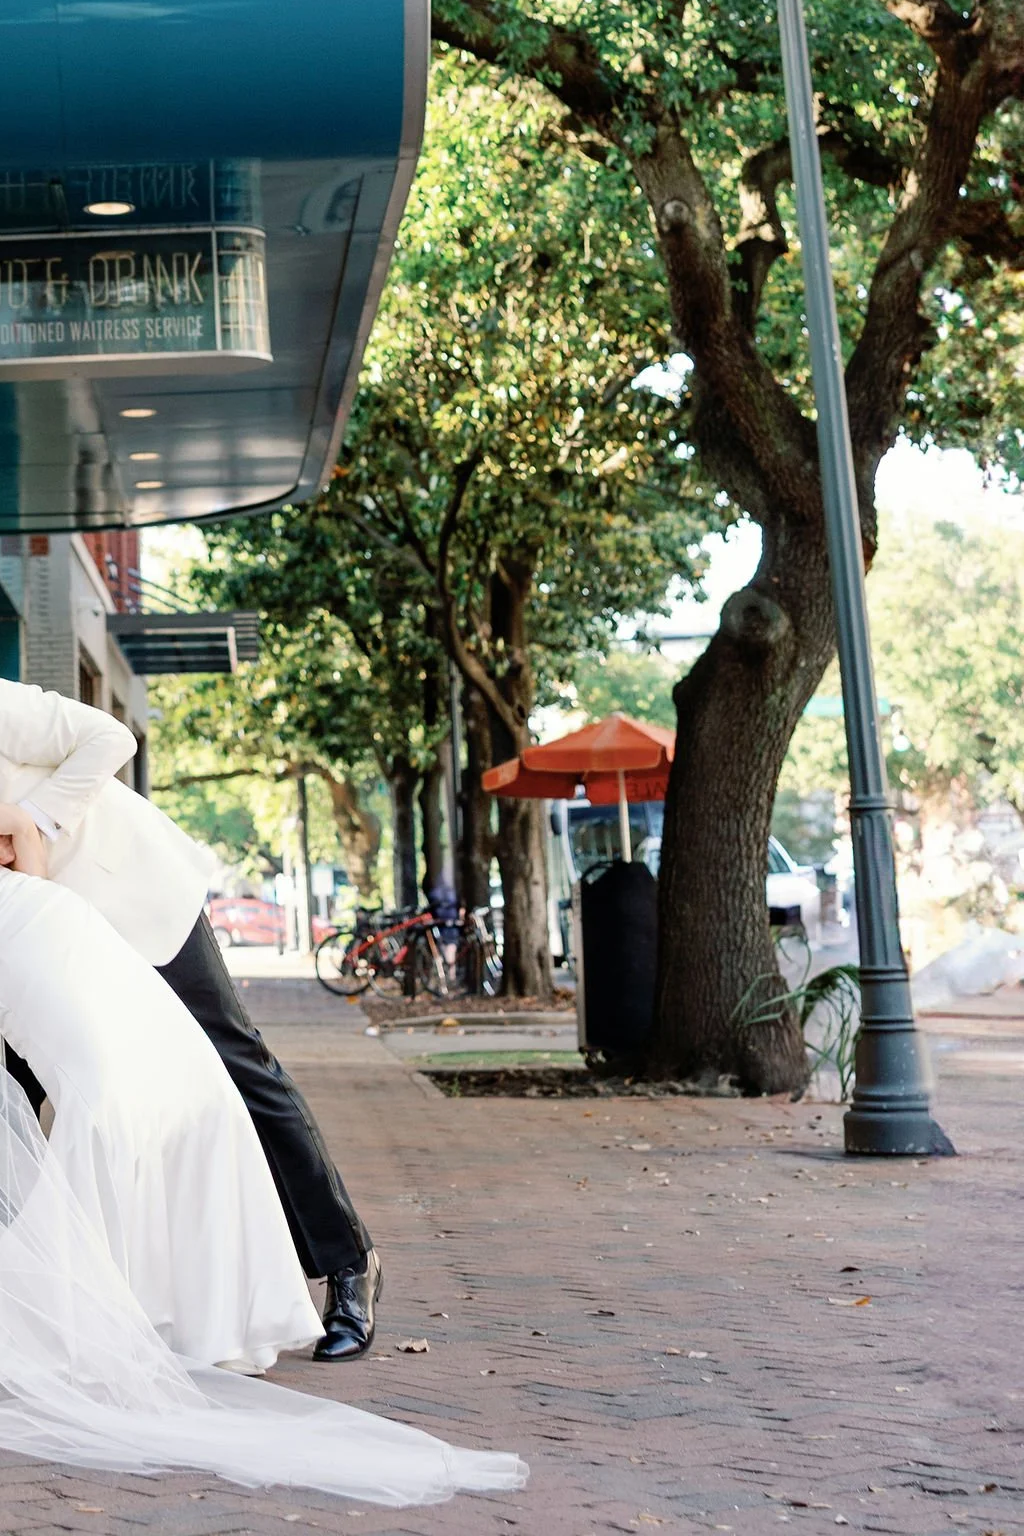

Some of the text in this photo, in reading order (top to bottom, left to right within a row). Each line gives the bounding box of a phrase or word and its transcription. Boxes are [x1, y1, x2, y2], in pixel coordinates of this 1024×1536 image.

[45, 257, 70, 308] &
[89, 251, 205, 308] DRINK
[69, 318, 140, 341] WAITRESS
[144, 315, 205, 337] SERVICE
